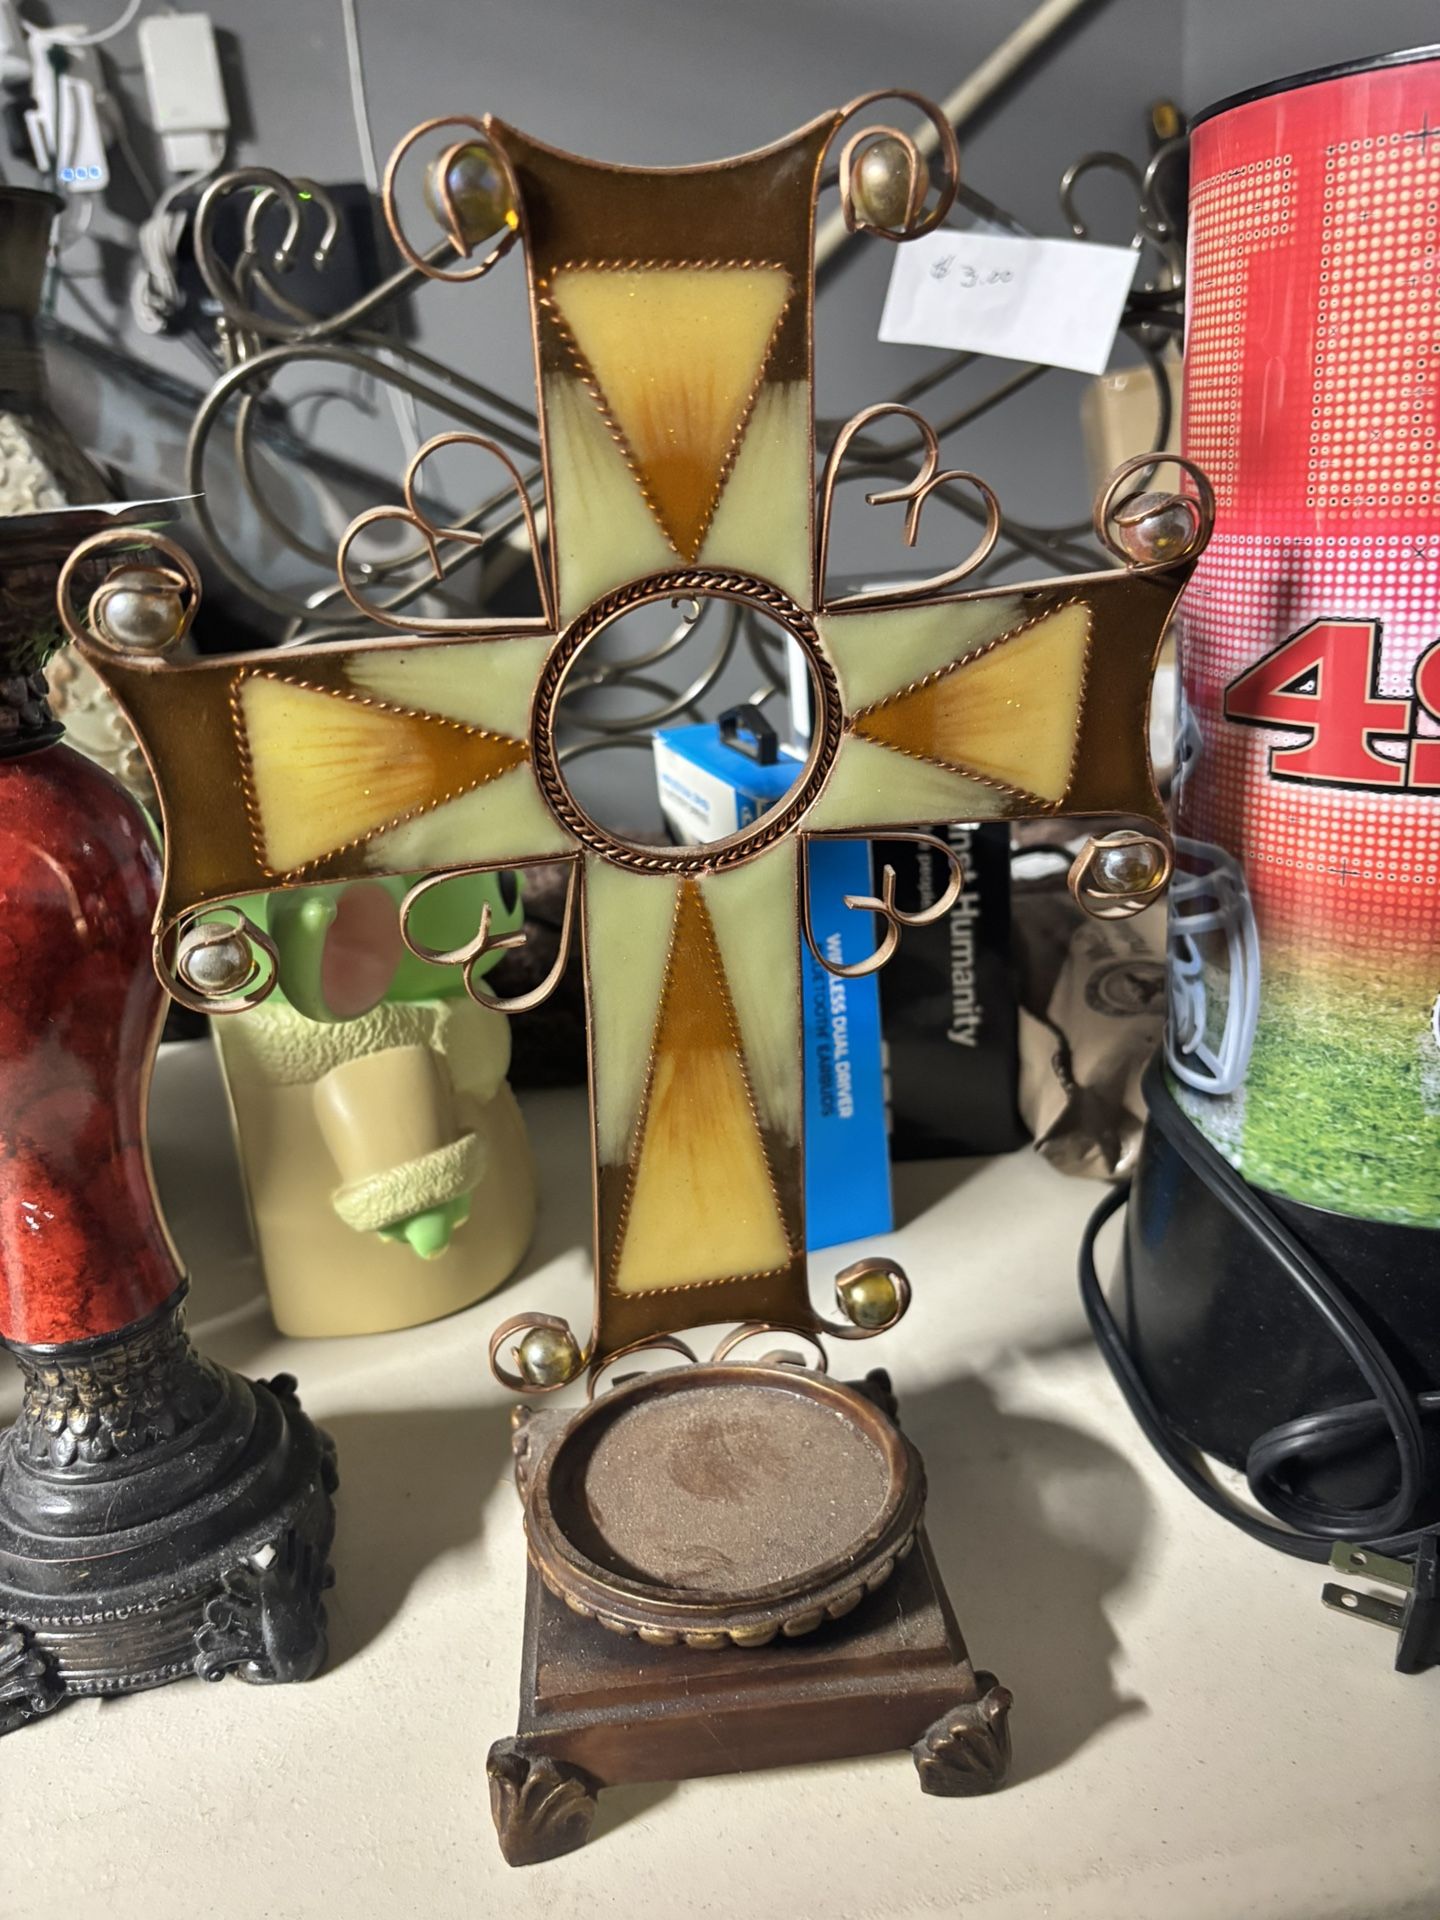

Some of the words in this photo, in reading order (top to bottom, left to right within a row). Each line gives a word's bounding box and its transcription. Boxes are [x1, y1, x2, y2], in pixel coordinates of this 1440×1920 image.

[1224, 616, 1440, 796] 4
[827, 932, 847, 1015] WIRLESS
[949, 893, 981, 1047] Humanity
[832, 1016, 849, 1060] DUAL
[817, 1043, 835, 1118] EARBUDS
[835, 1061, 854, 1119] DRIVER
